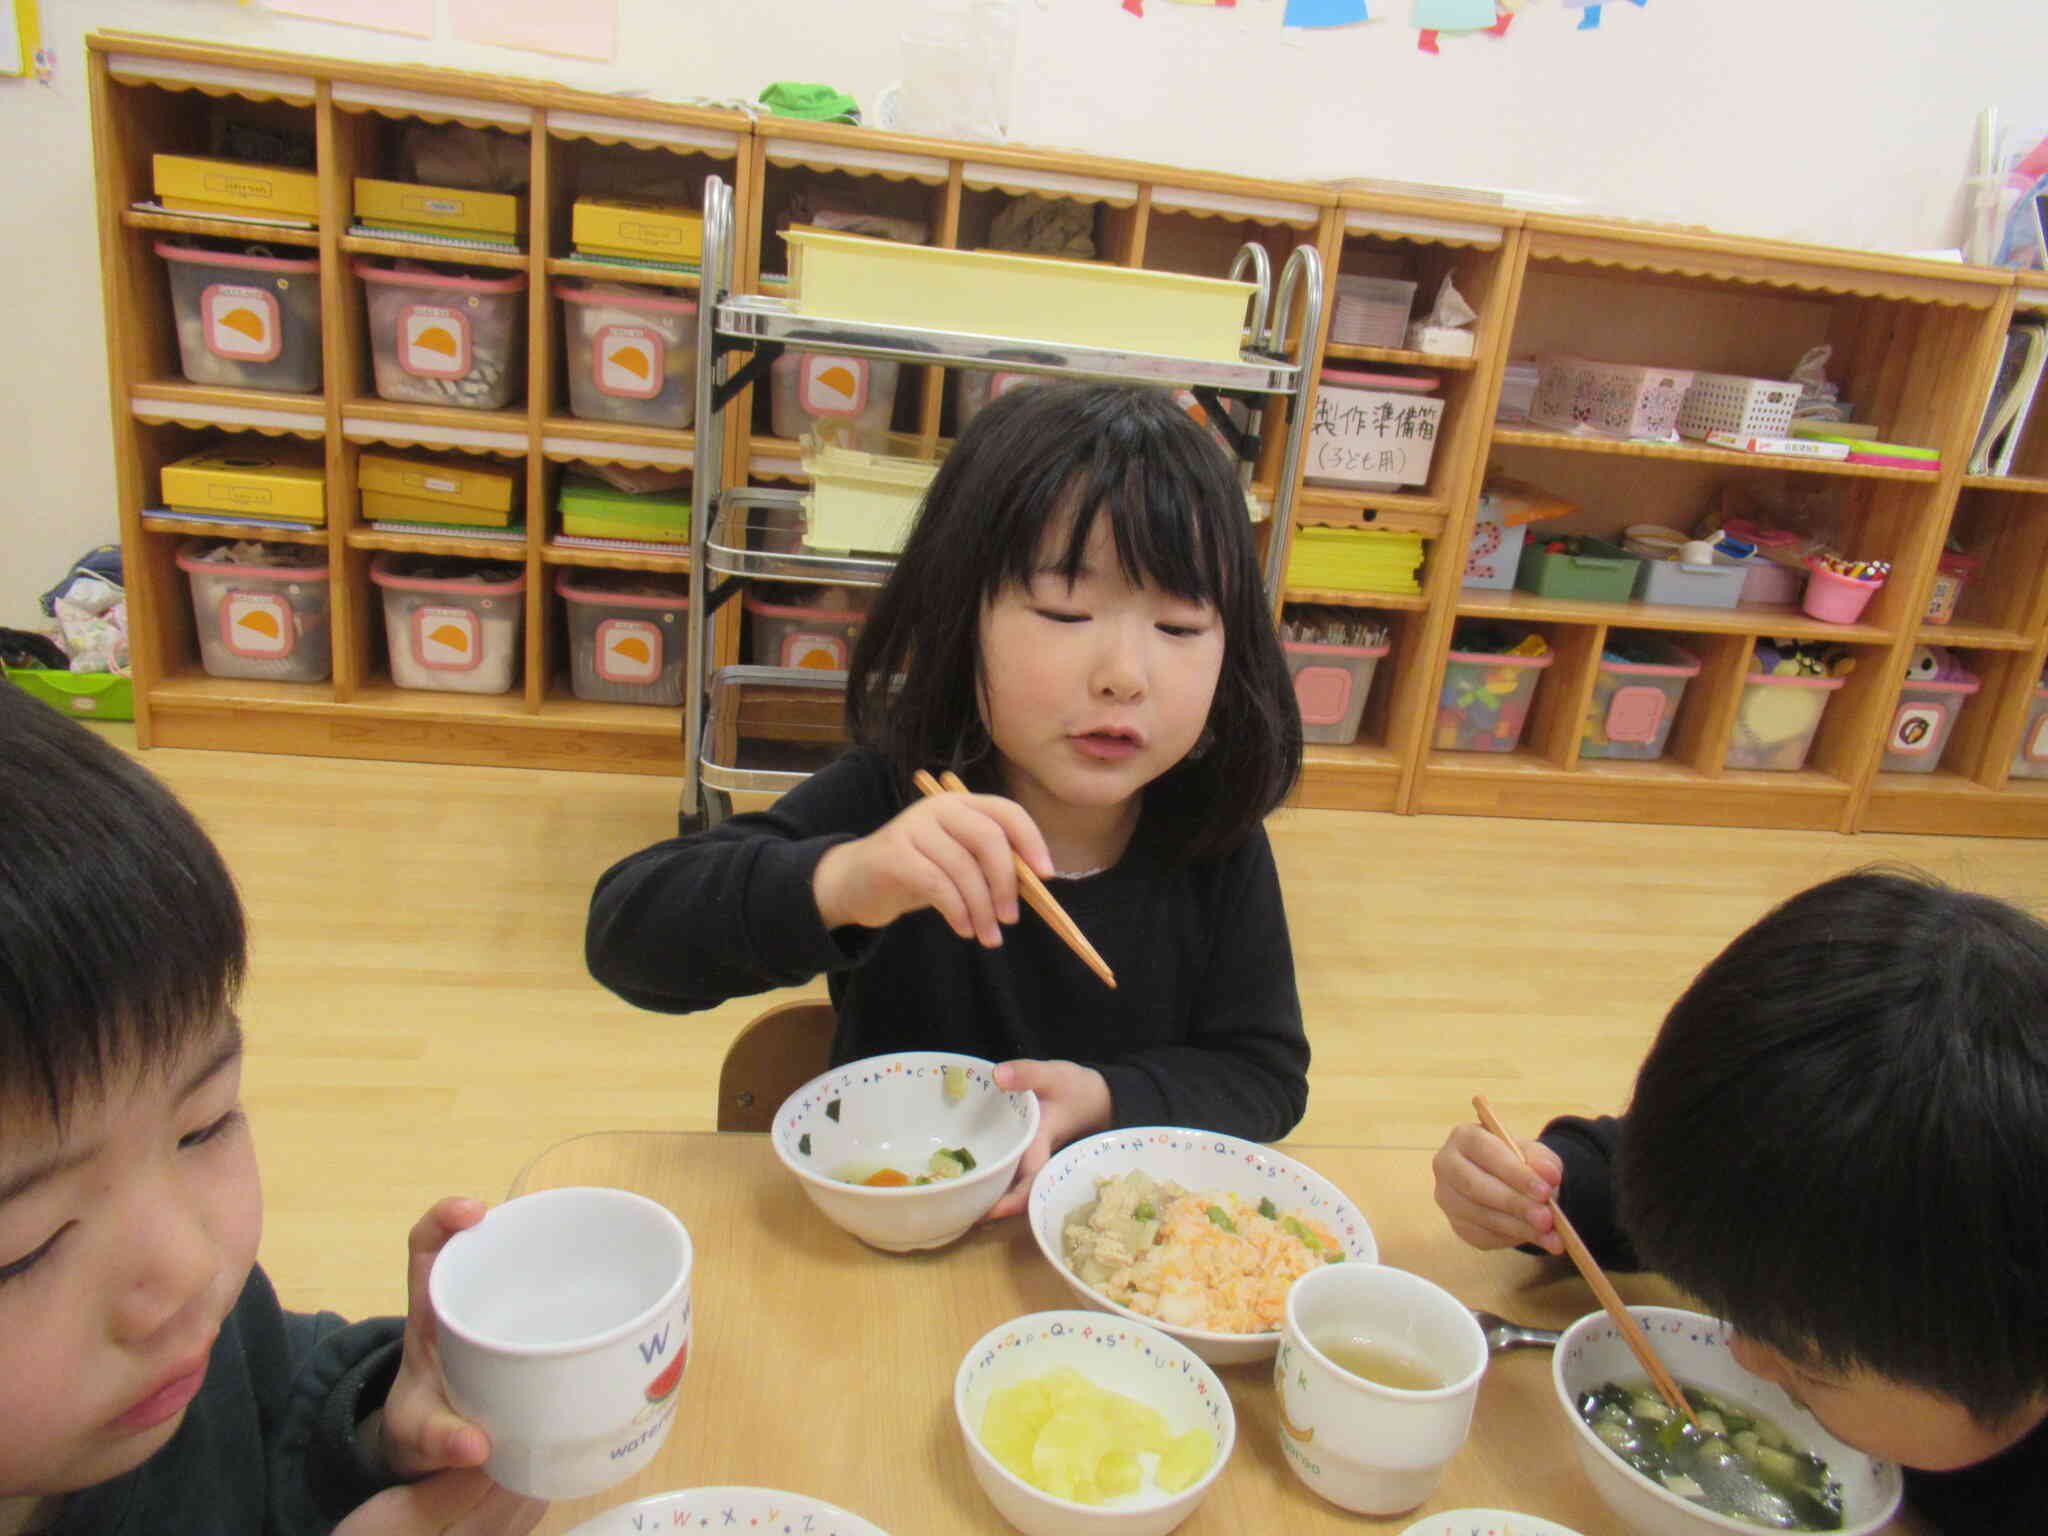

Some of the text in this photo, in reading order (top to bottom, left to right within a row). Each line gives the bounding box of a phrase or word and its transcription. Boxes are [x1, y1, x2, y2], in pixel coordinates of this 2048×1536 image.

[1312, 394, 1437, 440] 製作準備箱
[1214, 1143, 1226, 1154] Q
[639, 1320, 670, 1364] W
[1050, 1322, 1065, 1336] Q
[1106, 1334, 1116, 1346] S
[1182, 1360, 1191, 1373] V
[632, 1514, 644, 1531] V
[672, 1509, 692, 1527] W
[721, 1507, 736, 1526] X
